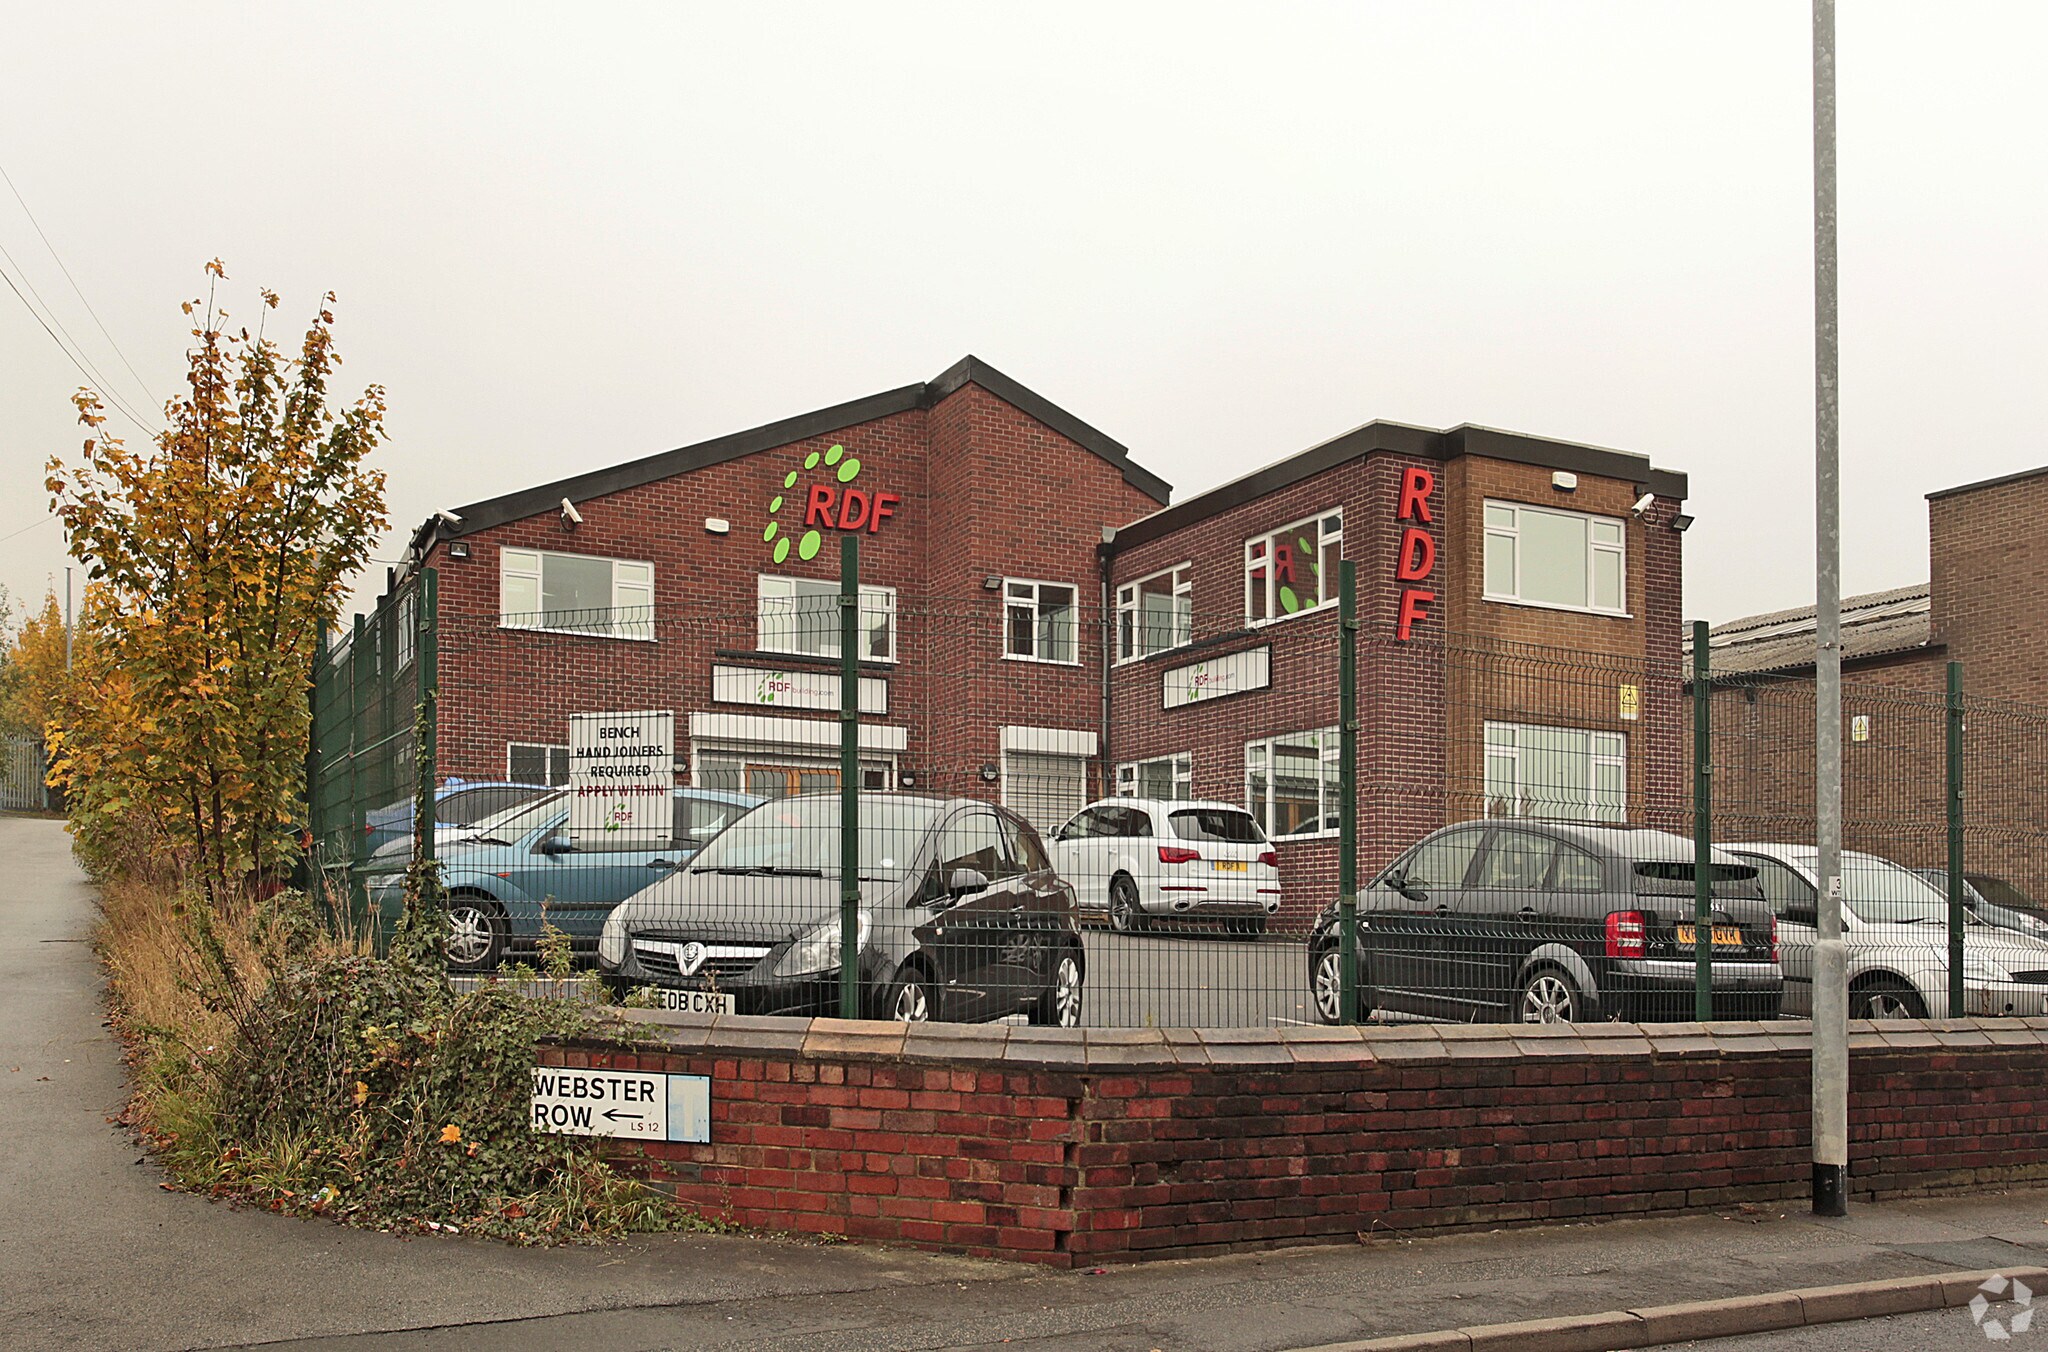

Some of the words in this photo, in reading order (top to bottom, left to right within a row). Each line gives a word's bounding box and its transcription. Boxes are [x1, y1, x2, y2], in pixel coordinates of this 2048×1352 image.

[804, 484, 900, 533] RDF
[1397, 467, 1436, 641] RDF
[1194, 673, 1208, 687] RDF
[768, 681, 791, 692] RDF
[792, 686, 834, 697] building.com
[600, 727, 640, 739] BENCH
[576, 747, 611, 758] HAND
[614, 745, 663, 757] JOINERS
[590, 765, 650, 778] REQUIRED
[577, 785, 615, 797] APPLY
[618, 784, 664, 797] WITHIN
[614, 812, 632, 821] RDF
[650, 991, 688, 1011] E08
[693, 994, 727, 1014] CXH
[534, 1075, 655, 1103] WEBSTER
[534, 1103, 592, 1128] ROW
[630, 1122, 644, 1131] LS
[648, 1122, 659, 1132] 12
